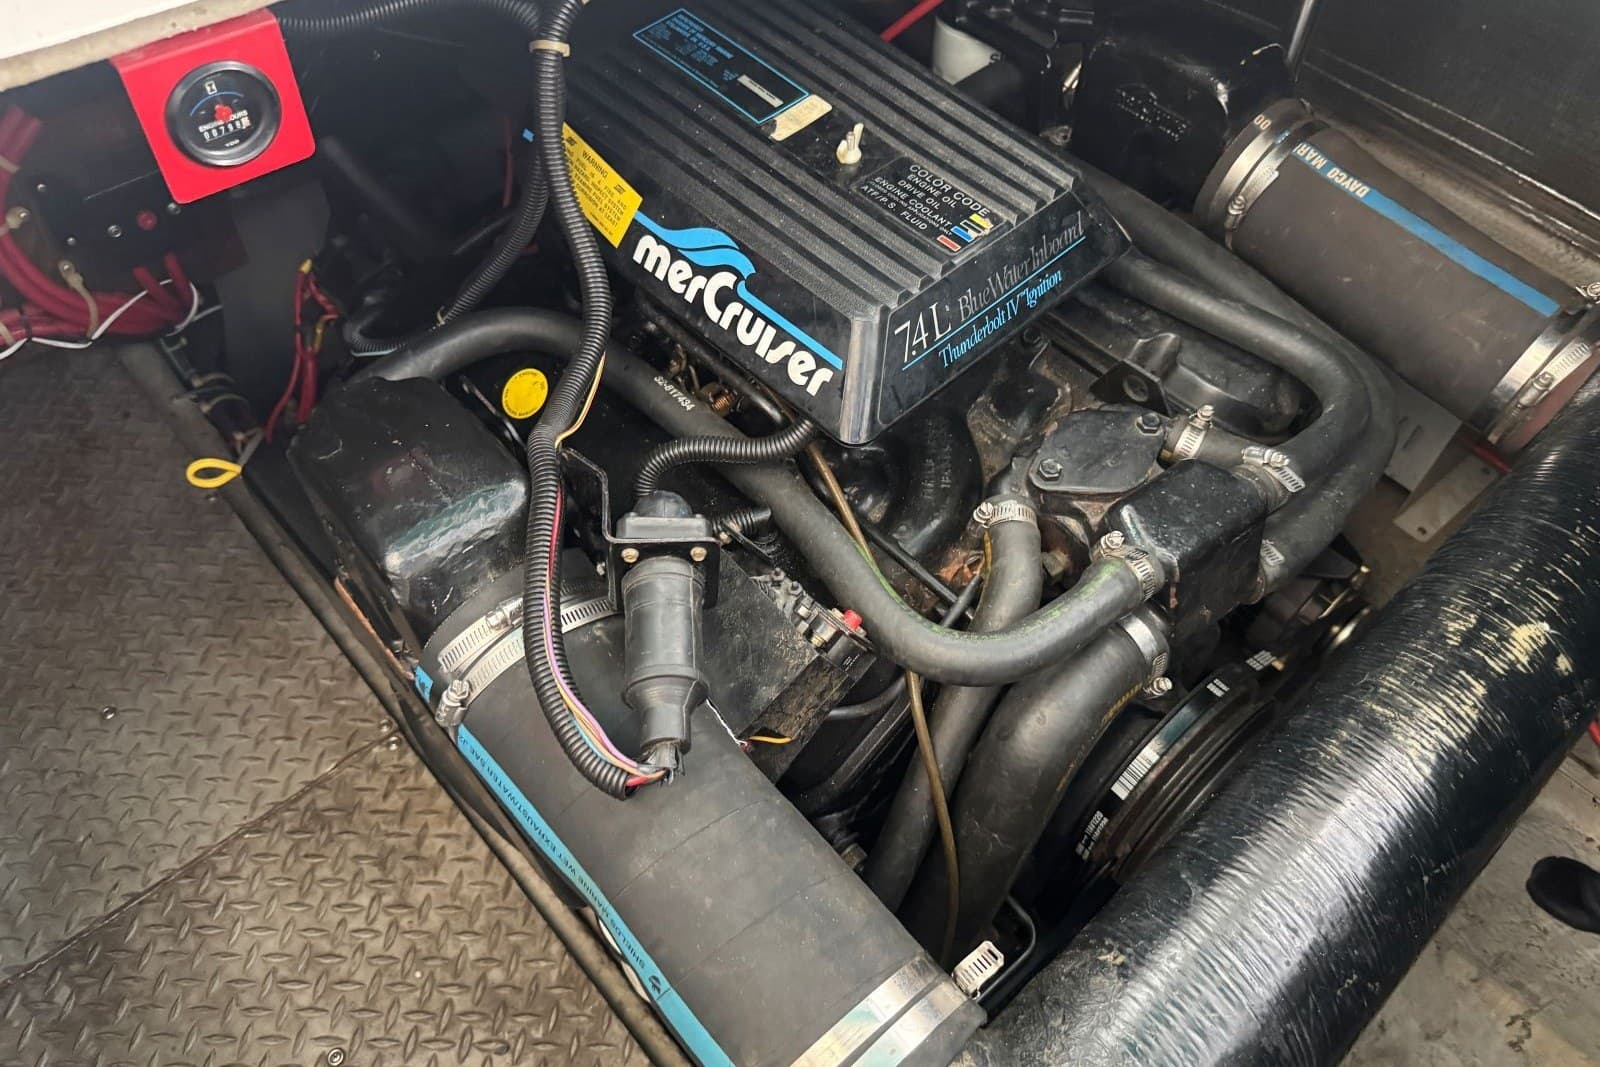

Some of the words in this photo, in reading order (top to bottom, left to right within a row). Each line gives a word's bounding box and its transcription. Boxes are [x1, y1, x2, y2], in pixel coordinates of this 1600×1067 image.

[581, 150, 608, 178] WARNING
[1326, 167, 1370, 198] DAYCO
[874, 177, 909, 200] ENGINE
[908, 198, 953, 228] COOLANT
[898, 180, 926, 199] DRIVE
[925, 197, 941, 210] OIL
[907, 173, 942, 198] ENGINE
[942, 195, 957, 209] OIL
[909, 164, 952, 193] COLOR
[953, 191, 991, 217] CODE
[900, 210, 928, 230] FLUID
[1030, 210, 1085, 272] Inboard
[938, 307, 1006, 368] Thunderbolt
[1023, 269, 1063, 309] Ignition
[558, 852, 577, 876] WET
[578, 876, 610, 918] MARINE
[610, 918, 646, 970] SHIELDS
